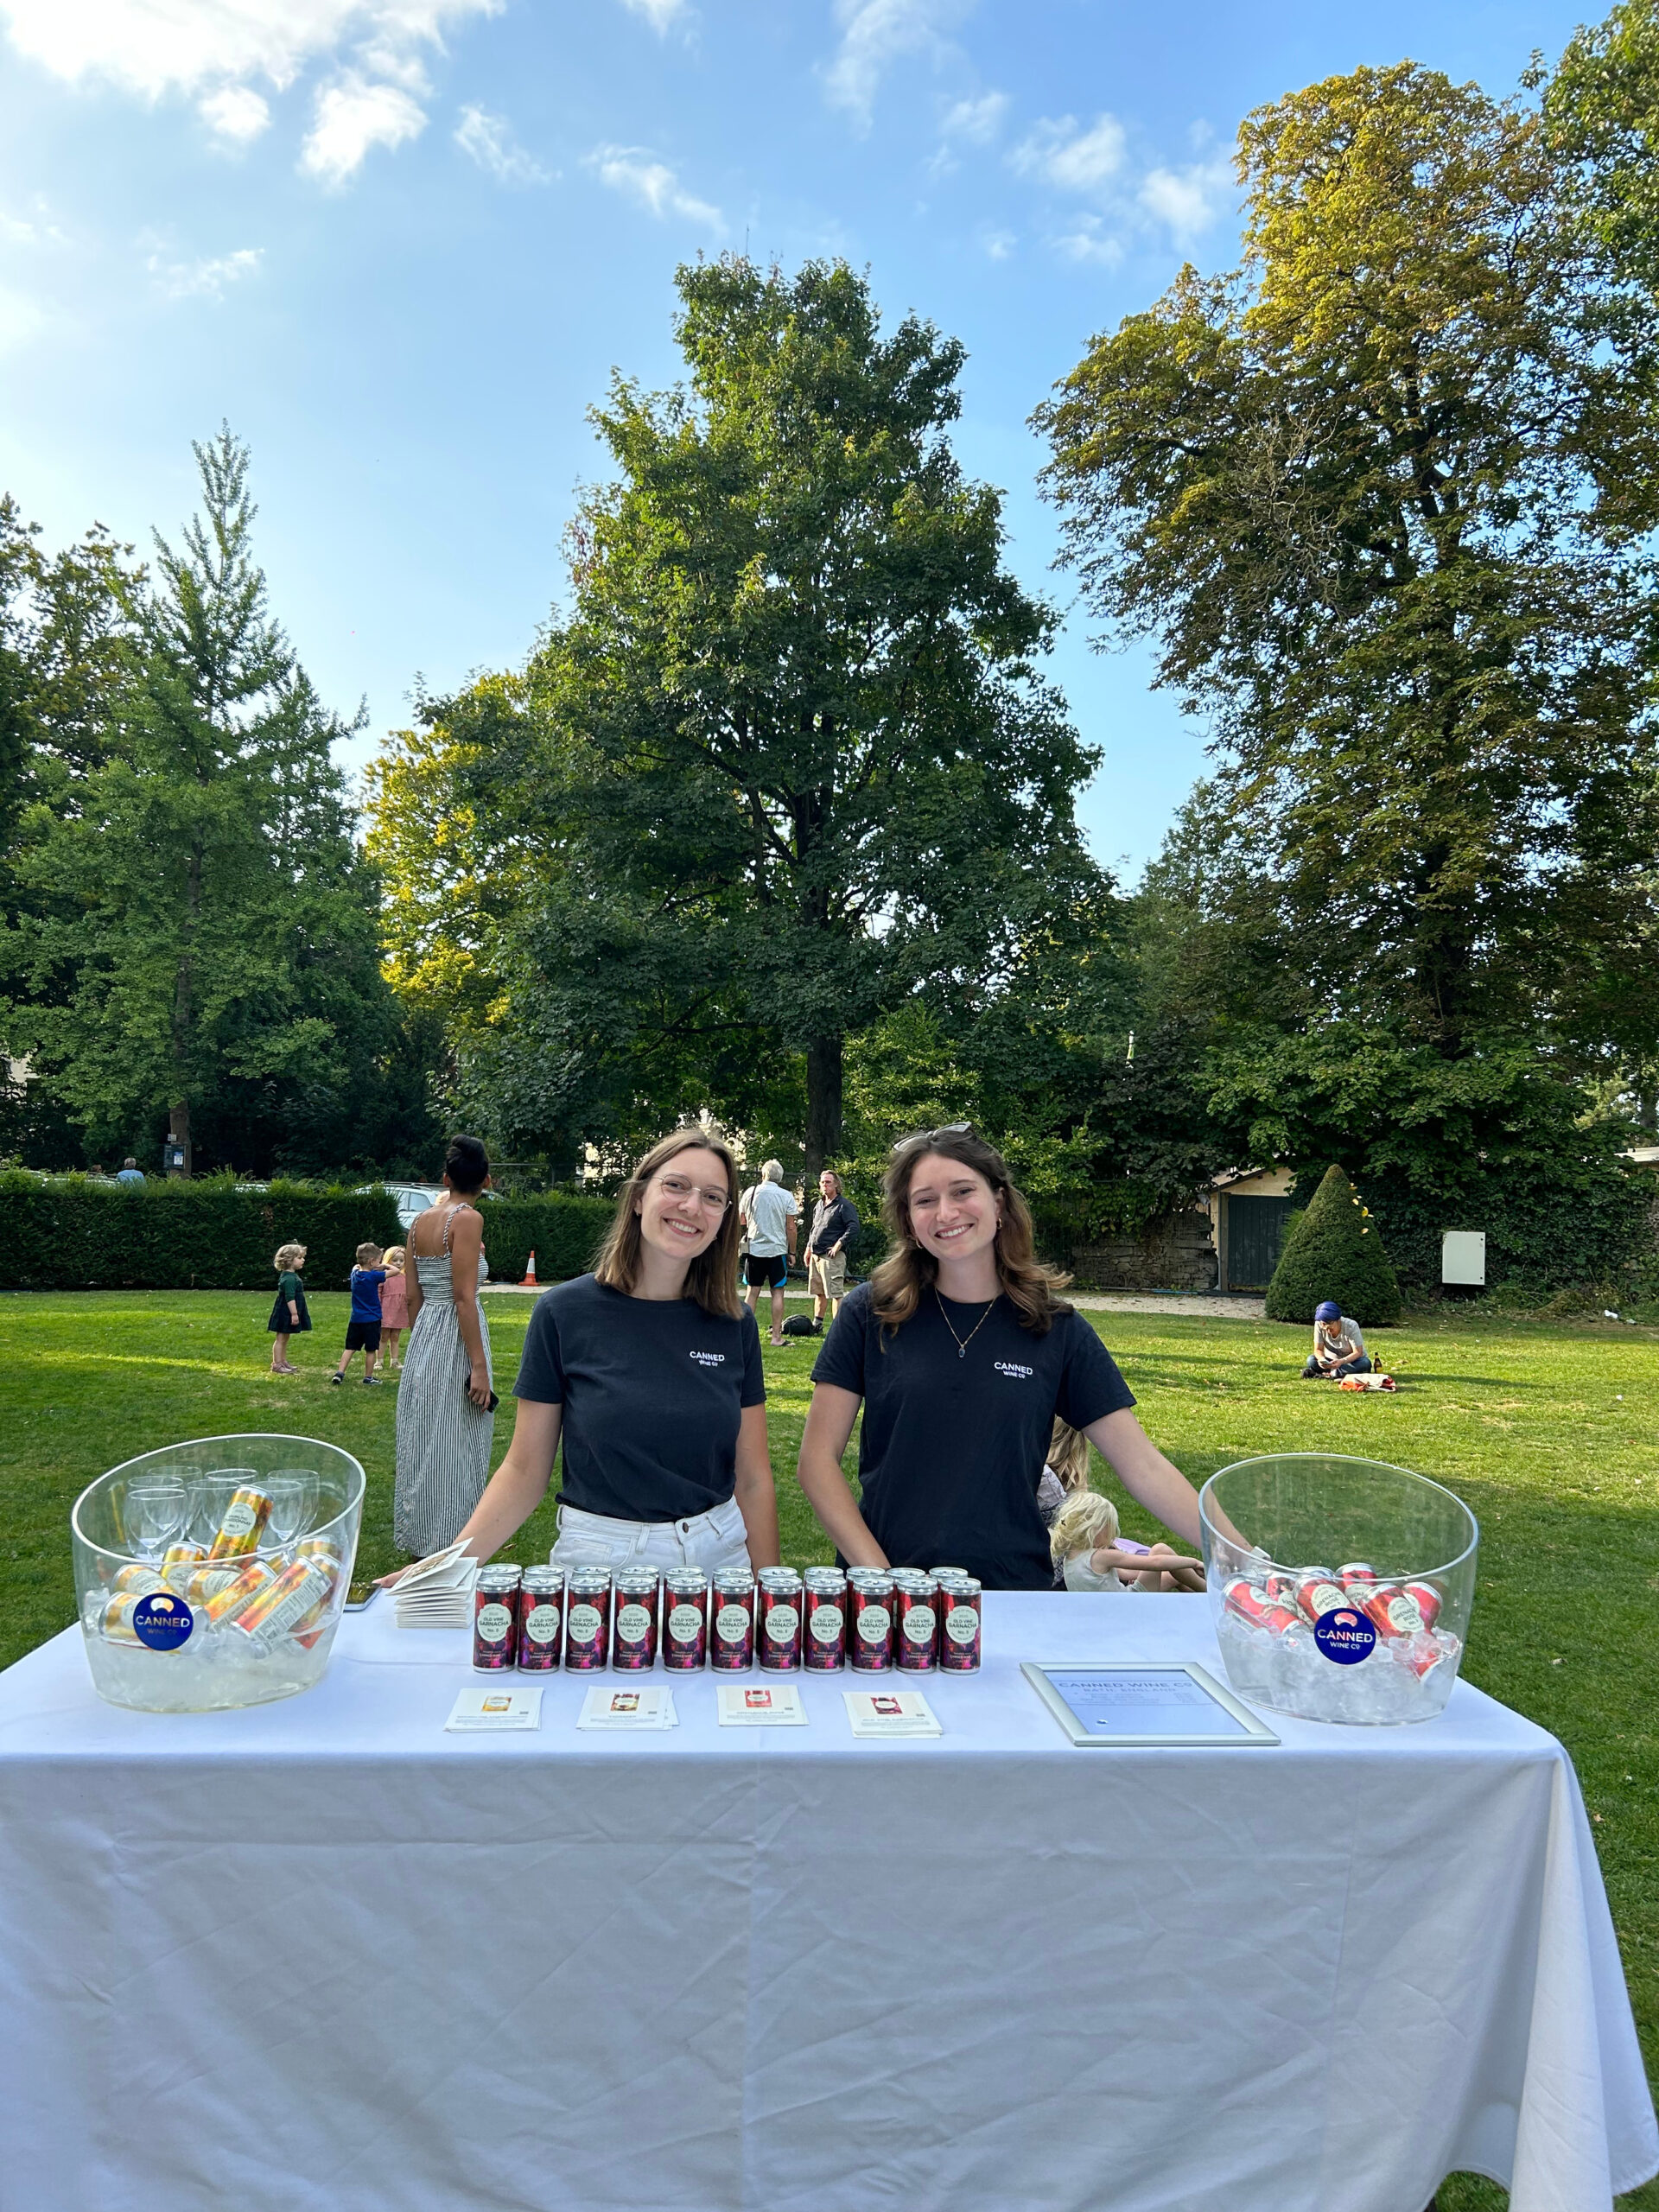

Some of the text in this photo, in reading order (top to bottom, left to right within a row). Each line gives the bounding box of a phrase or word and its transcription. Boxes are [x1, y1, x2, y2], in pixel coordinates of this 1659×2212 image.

[689, 1351, 725, 1362] CANNED
[994, 1362, 1033, 1376] CANNED
[1002, 1370, 1018, 1378] WINE
[135, 1615, 191, 1628] CANNED
[1317, 1629, 1374, 1643] CANNED
